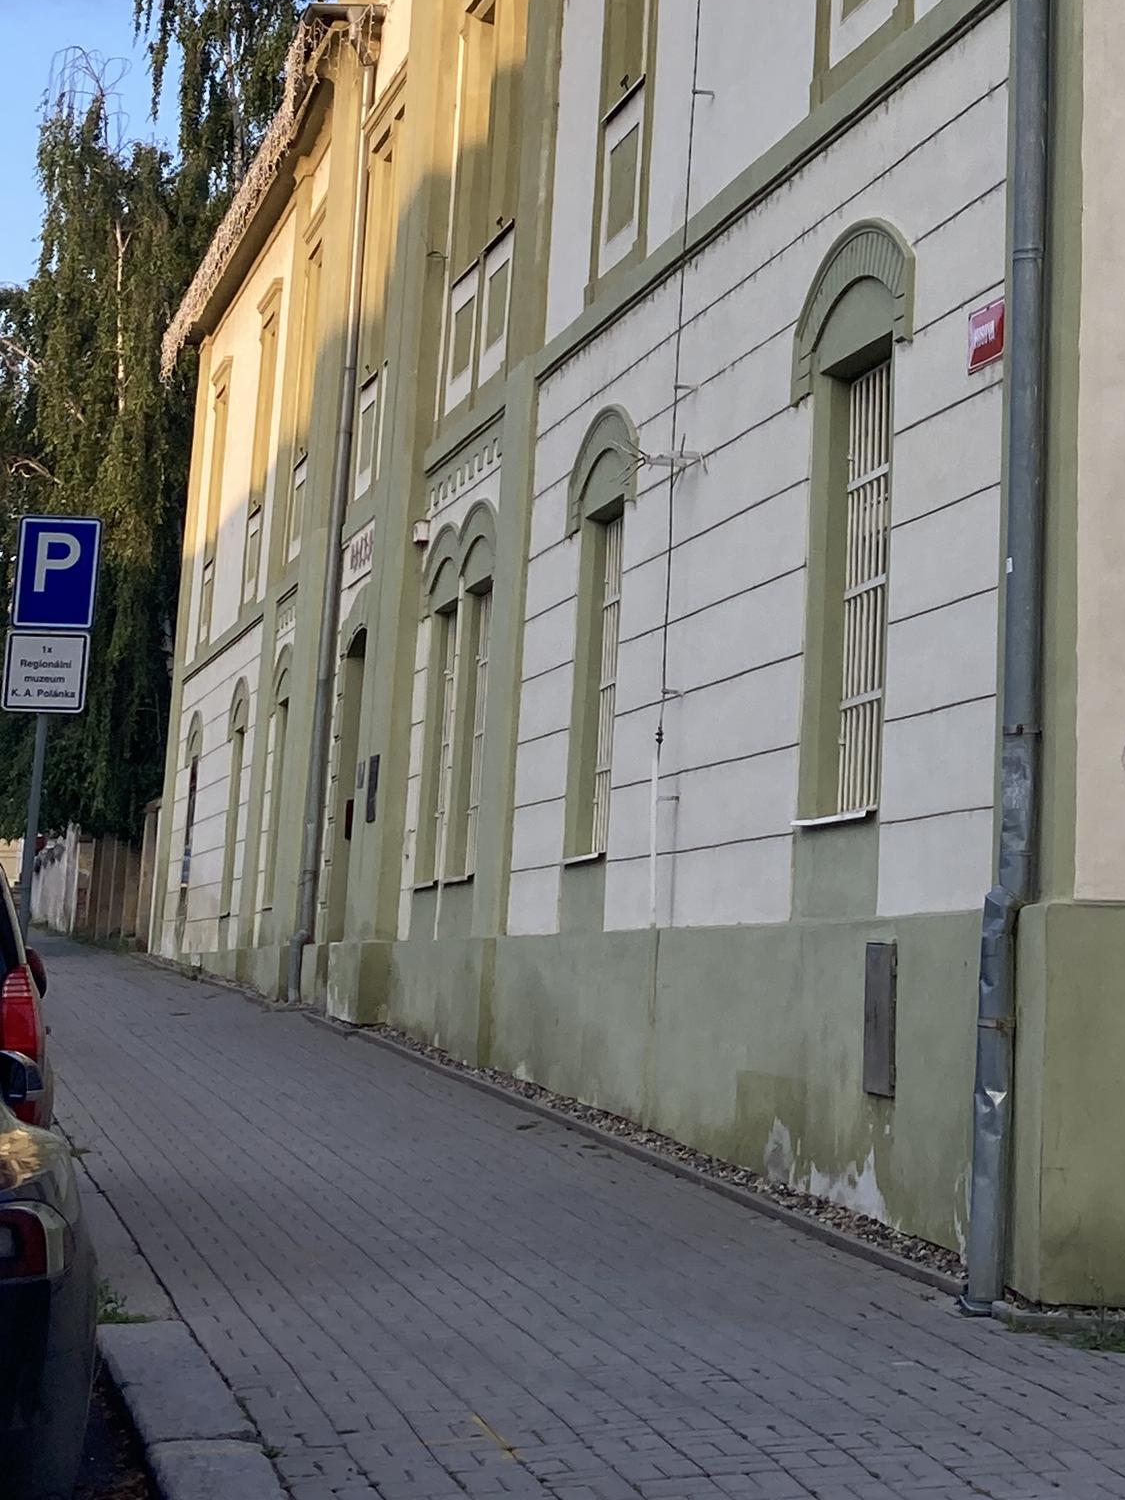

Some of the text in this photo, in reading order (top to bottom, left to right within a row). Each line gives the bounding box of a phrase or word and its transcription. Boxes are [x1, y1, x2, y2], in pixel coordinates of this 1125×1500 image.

[33, 531, 81, 592] P
[42, 645, 53, 654] 1x
[20, 658, 72, 670] Regionální
[24, 675, 66, 683] muzeum
[11, 688, 21, 697] K.
[37, 688, 76, 699] Polánka
